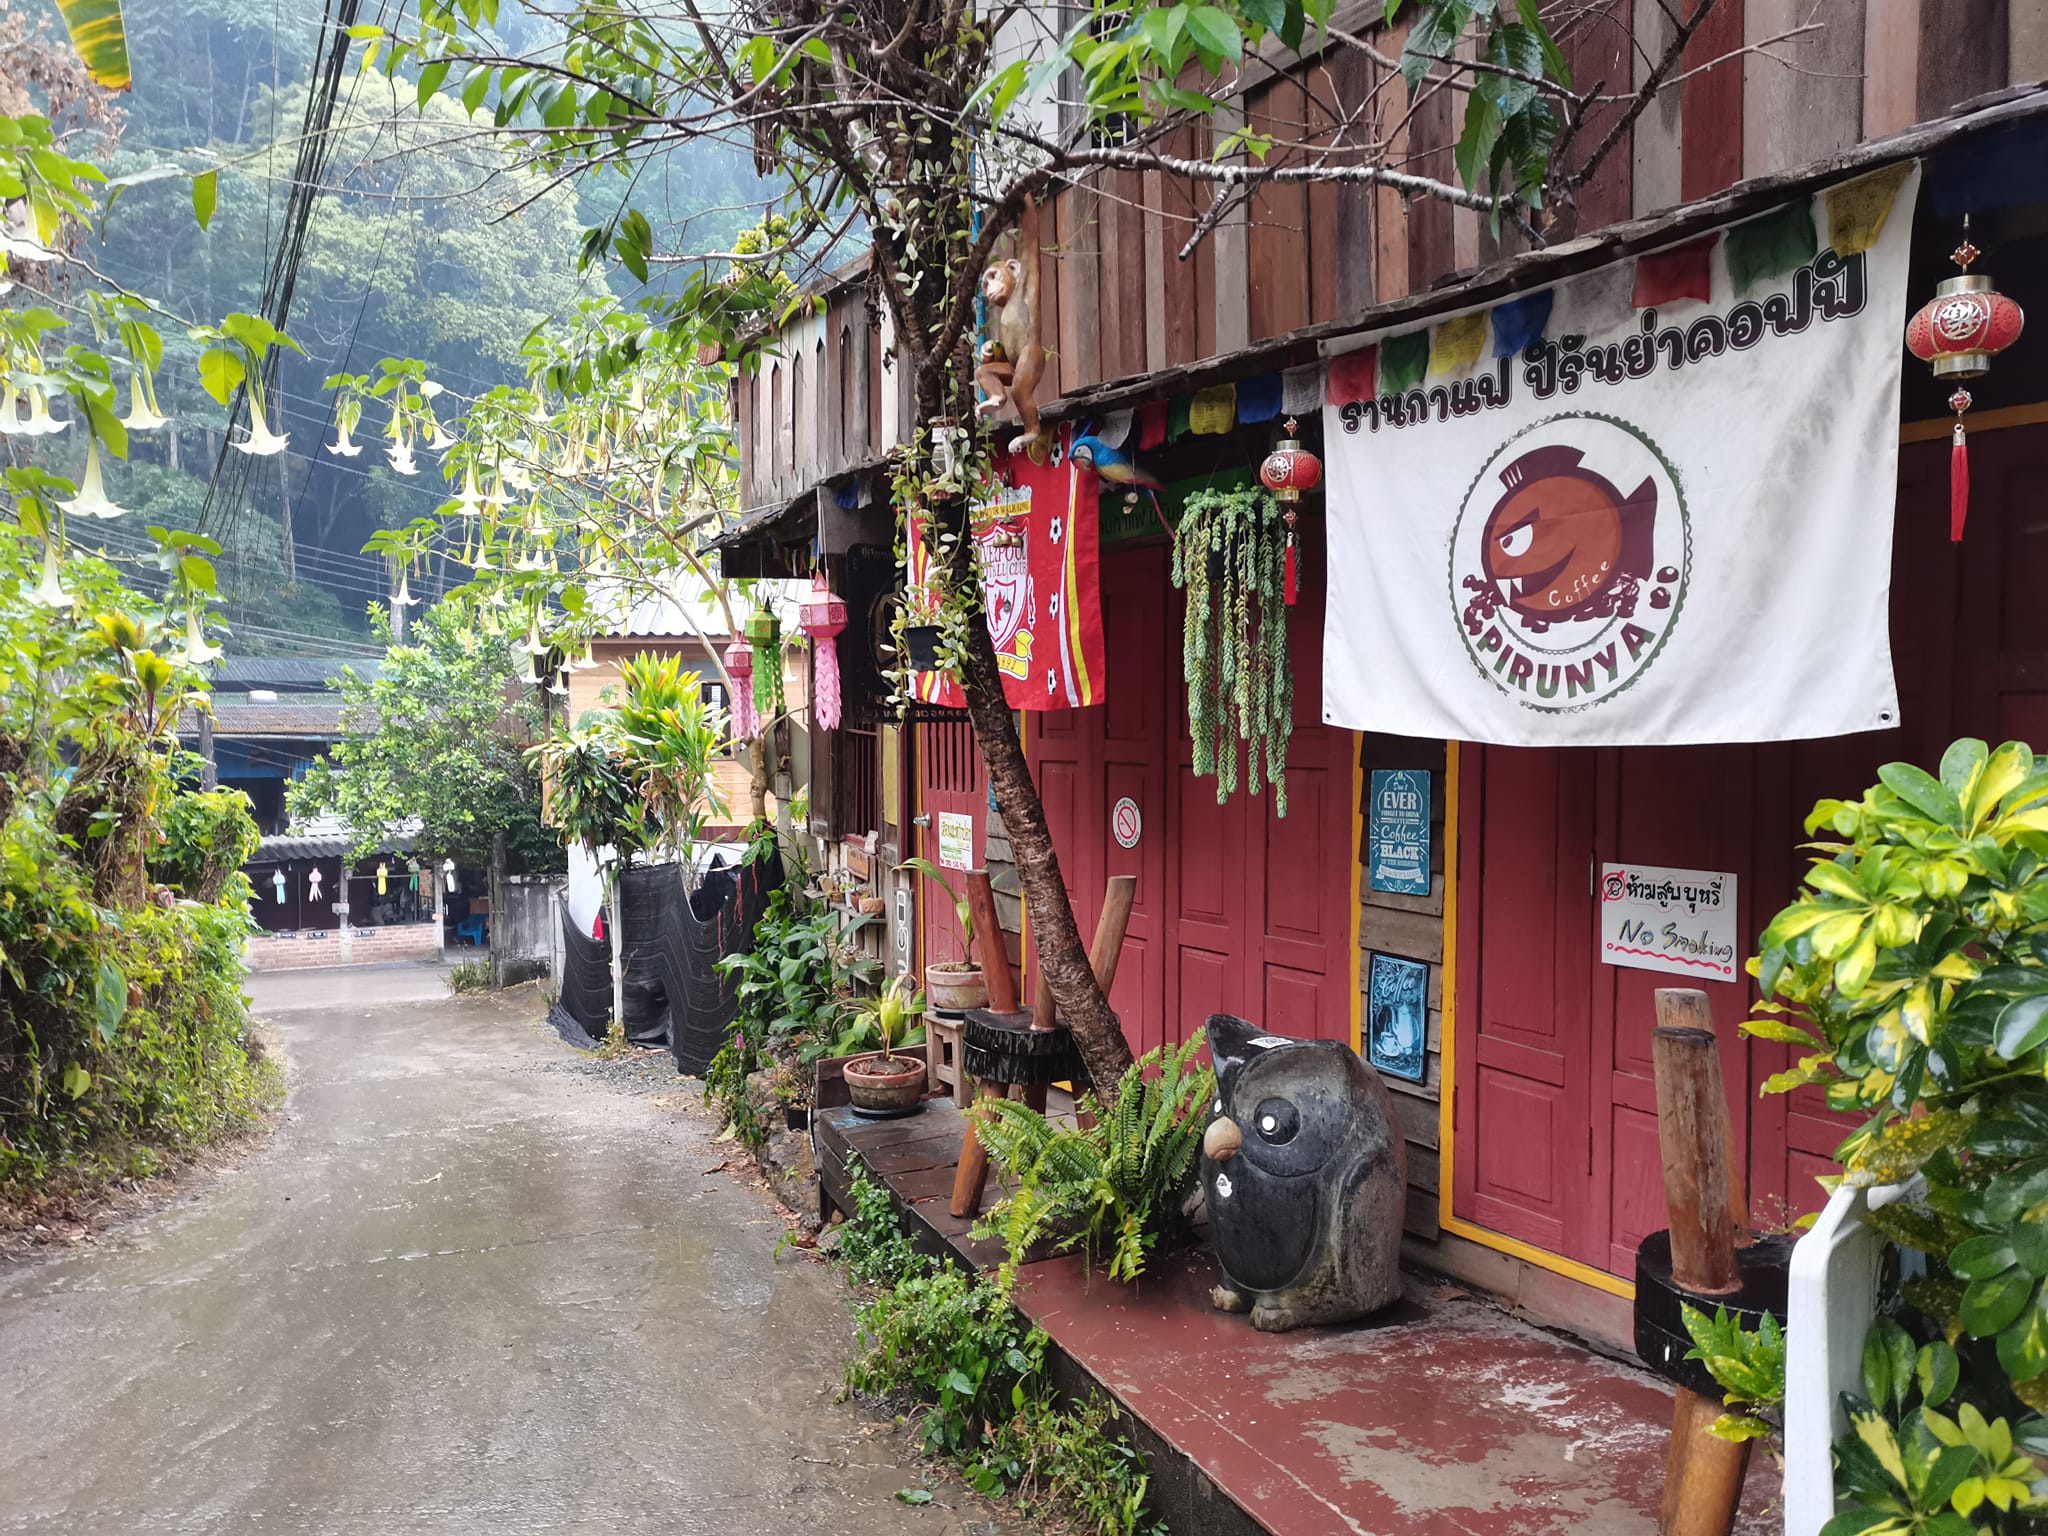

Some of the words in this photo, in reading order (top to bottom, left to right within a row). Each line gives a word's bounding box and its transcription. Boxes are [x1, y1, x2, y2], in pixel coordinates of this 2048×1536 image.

[1548, 561, 1609, 606] Coffee
[1476, 622, 1656, 698] PIRUNYA
[1383, 791, 1417, 810] EVER
[1381, 824, 1419, 843] Coffee
[1380, 844, 1419, 860] BLACK
[1662, 922, 1733, 963] Smoking
[1379, 966, 1415, 1002] Coffee
